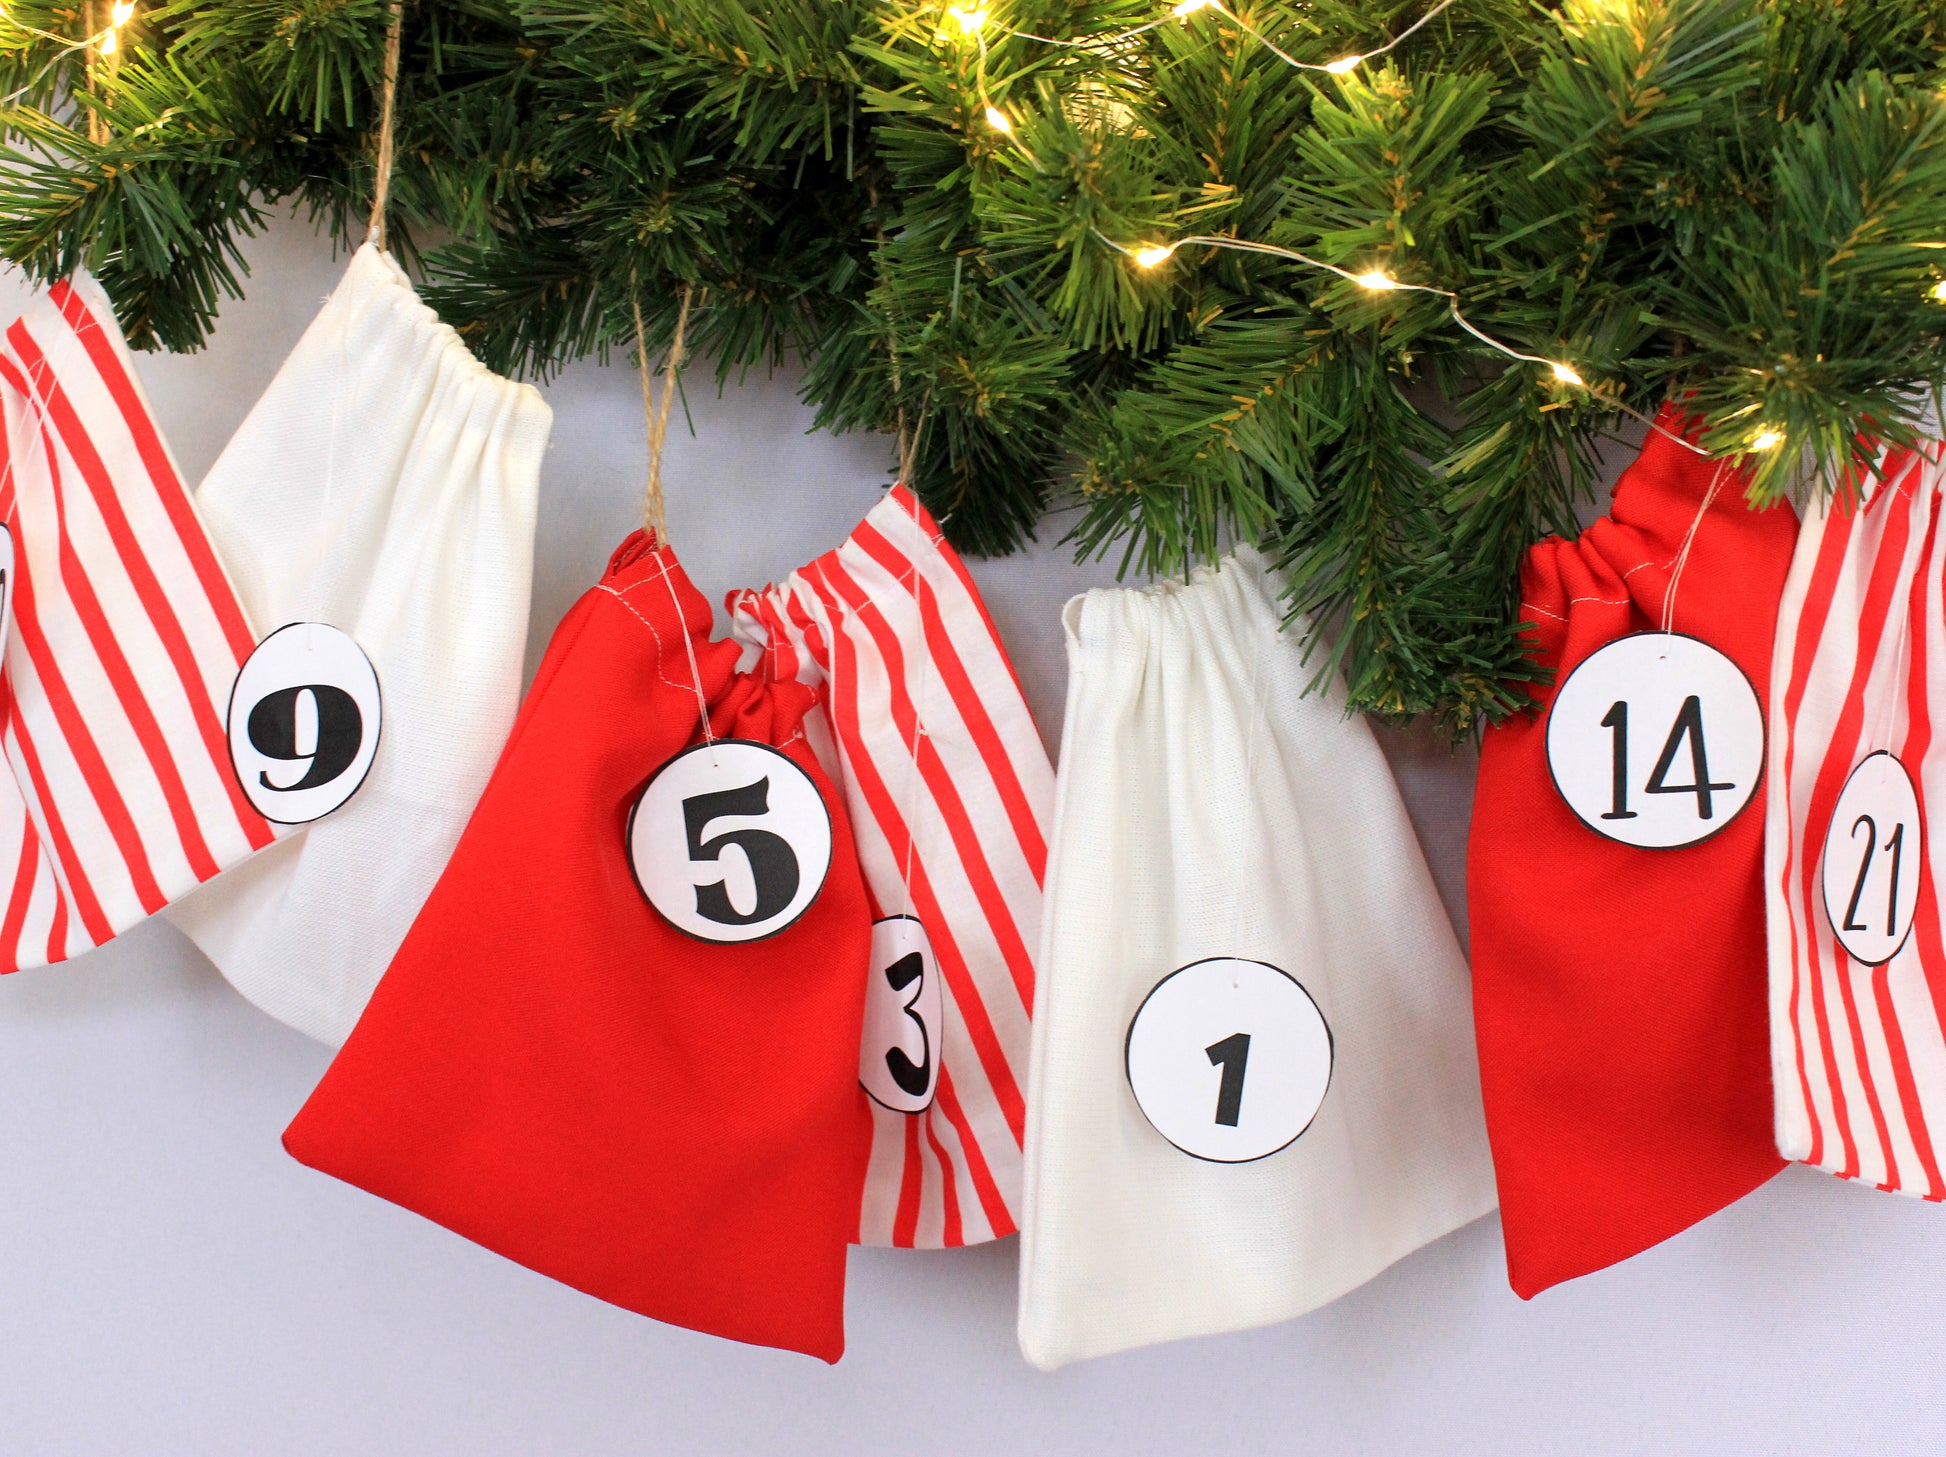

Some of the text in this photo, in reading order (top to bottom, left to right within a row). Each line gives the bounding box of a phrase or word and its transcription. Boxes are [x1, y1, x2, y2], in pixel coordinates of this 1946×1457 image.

[247, 684, 363, 792] 9
[1601, 696, 1736, 820] 14
[682, 776, 801, 926] 5
[1843, 814, 1904, 937] 21
[884, 951, 931, 1097] 3
[1204, 1032, 1251, 1128] 1
